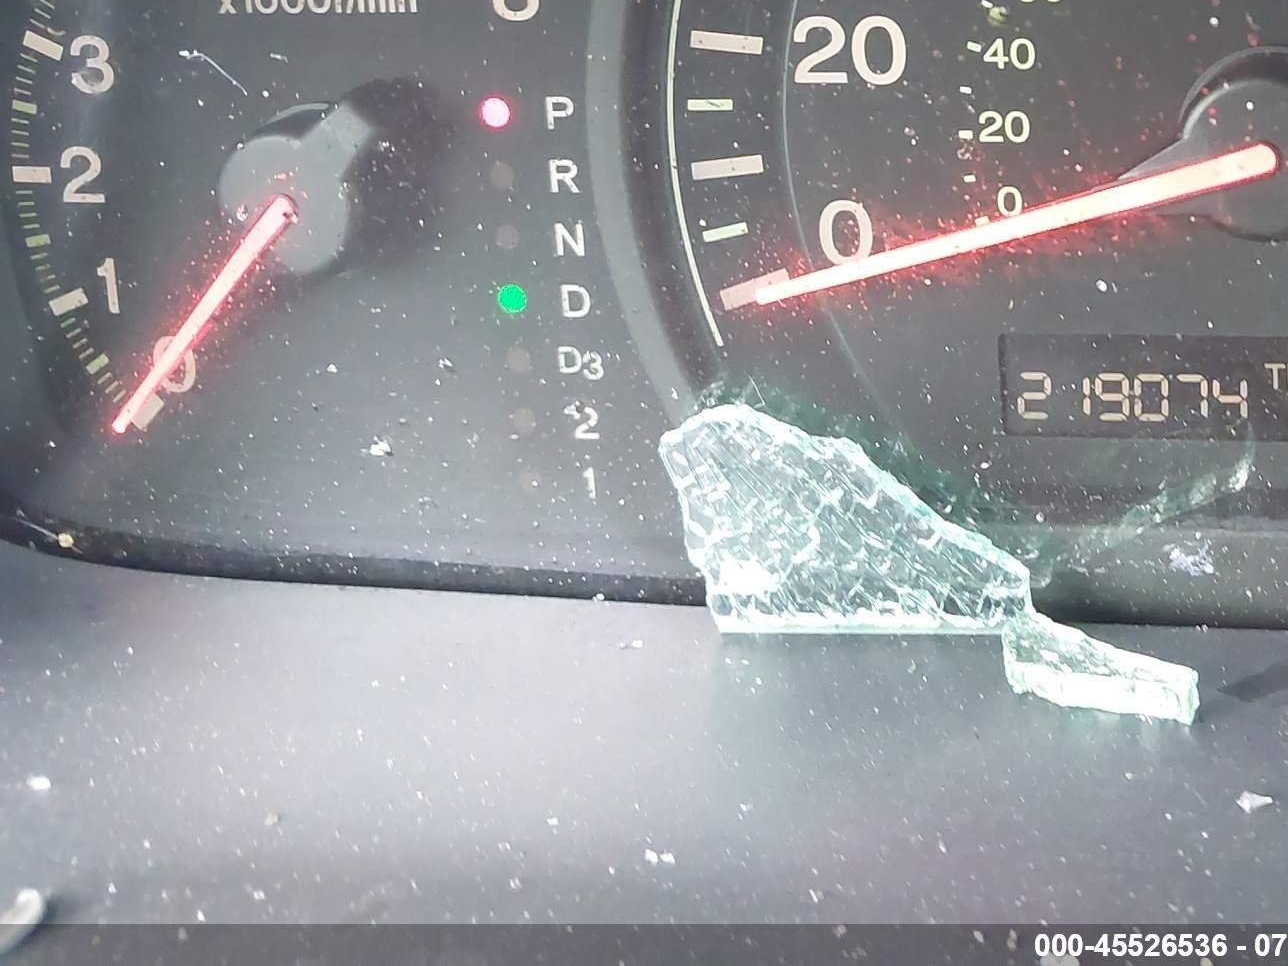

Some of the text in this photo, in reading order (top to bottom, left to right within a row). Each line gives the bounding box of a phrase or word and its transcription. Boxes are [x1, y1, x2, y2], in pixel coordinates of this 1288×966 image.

[69, 35, 114, 94] 3
[793, 15, 907, 85] 20
[983, 38, 1036, 70] 40
[545, 96, 574, 130] P
[978, 110, 1030, 143] 20
[60, 146, 106, 203] 2
[548, 159, 579, 193] R
[997, 186, 1022, 217] 0
[554, 223, 585, 257] N
[819, 199, 873, 266] 0
[97, 257, 120, 314] 1
[560, 285, 590, 318] D
[152, 335, 196, 394] 0
[557, 345, 605, 381] D3
[1017, 371, 1249, 422] 219074
[574, 405, 600, 440] 2
[582, 466, 597, 500] 1
